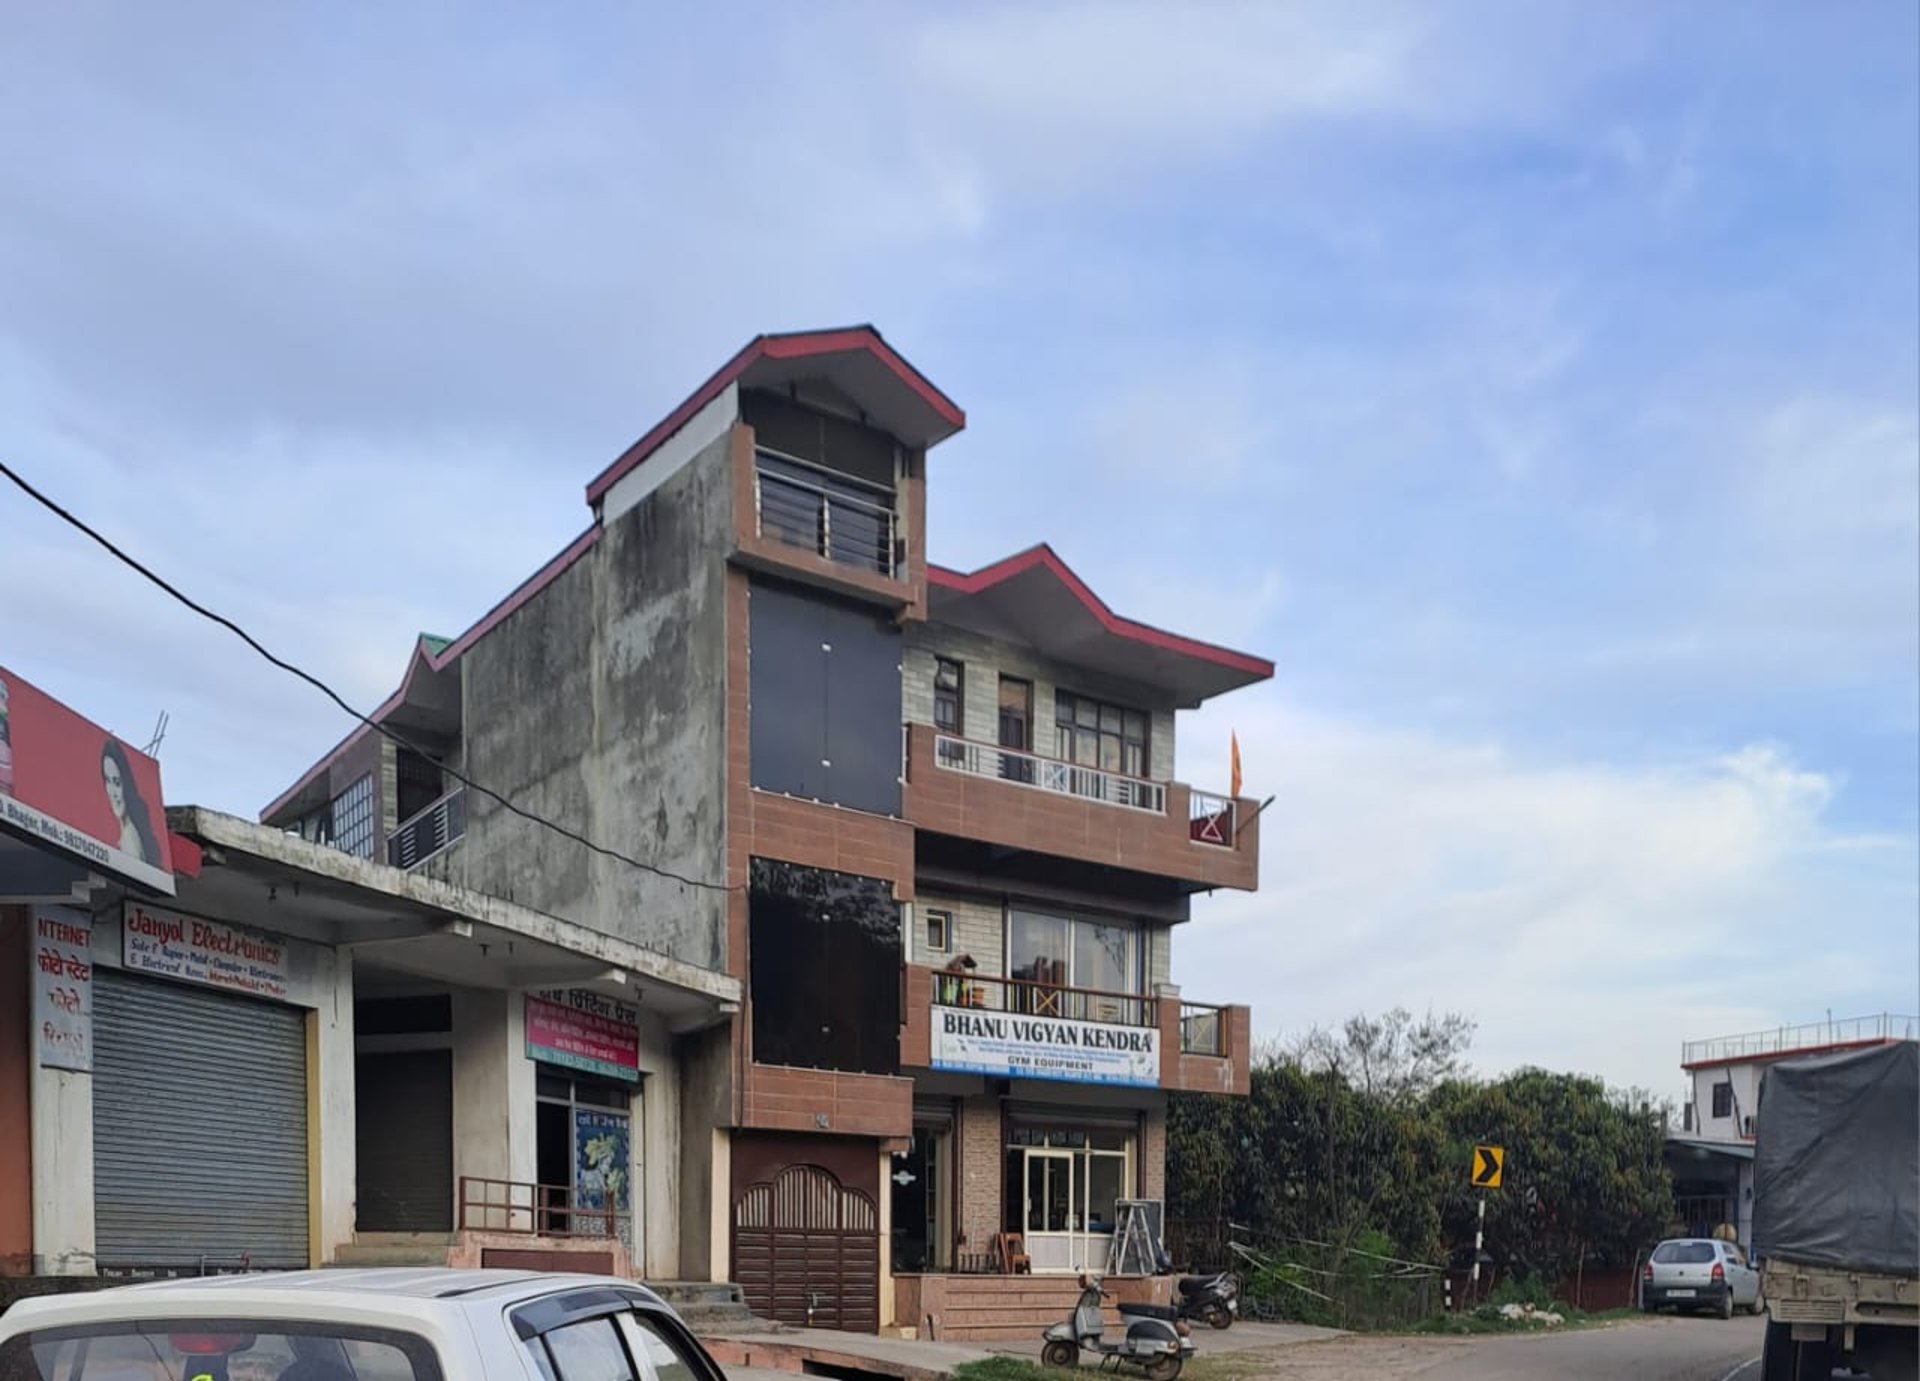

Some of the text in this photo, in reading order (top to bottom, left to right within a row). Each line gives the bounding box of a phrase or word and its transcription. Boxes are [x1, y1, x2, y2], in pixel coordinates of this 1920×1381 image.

[192, 921, 281, 965] Electronics
[943, 1013, 1007, 1040] BHANU
[1013, 1020, 1078, 1046] VIGYAN
[1083, 1028, 1152, 1053] KENDRA
[1008, 1056, 1094, 1071] GYM EQUIPMENT
